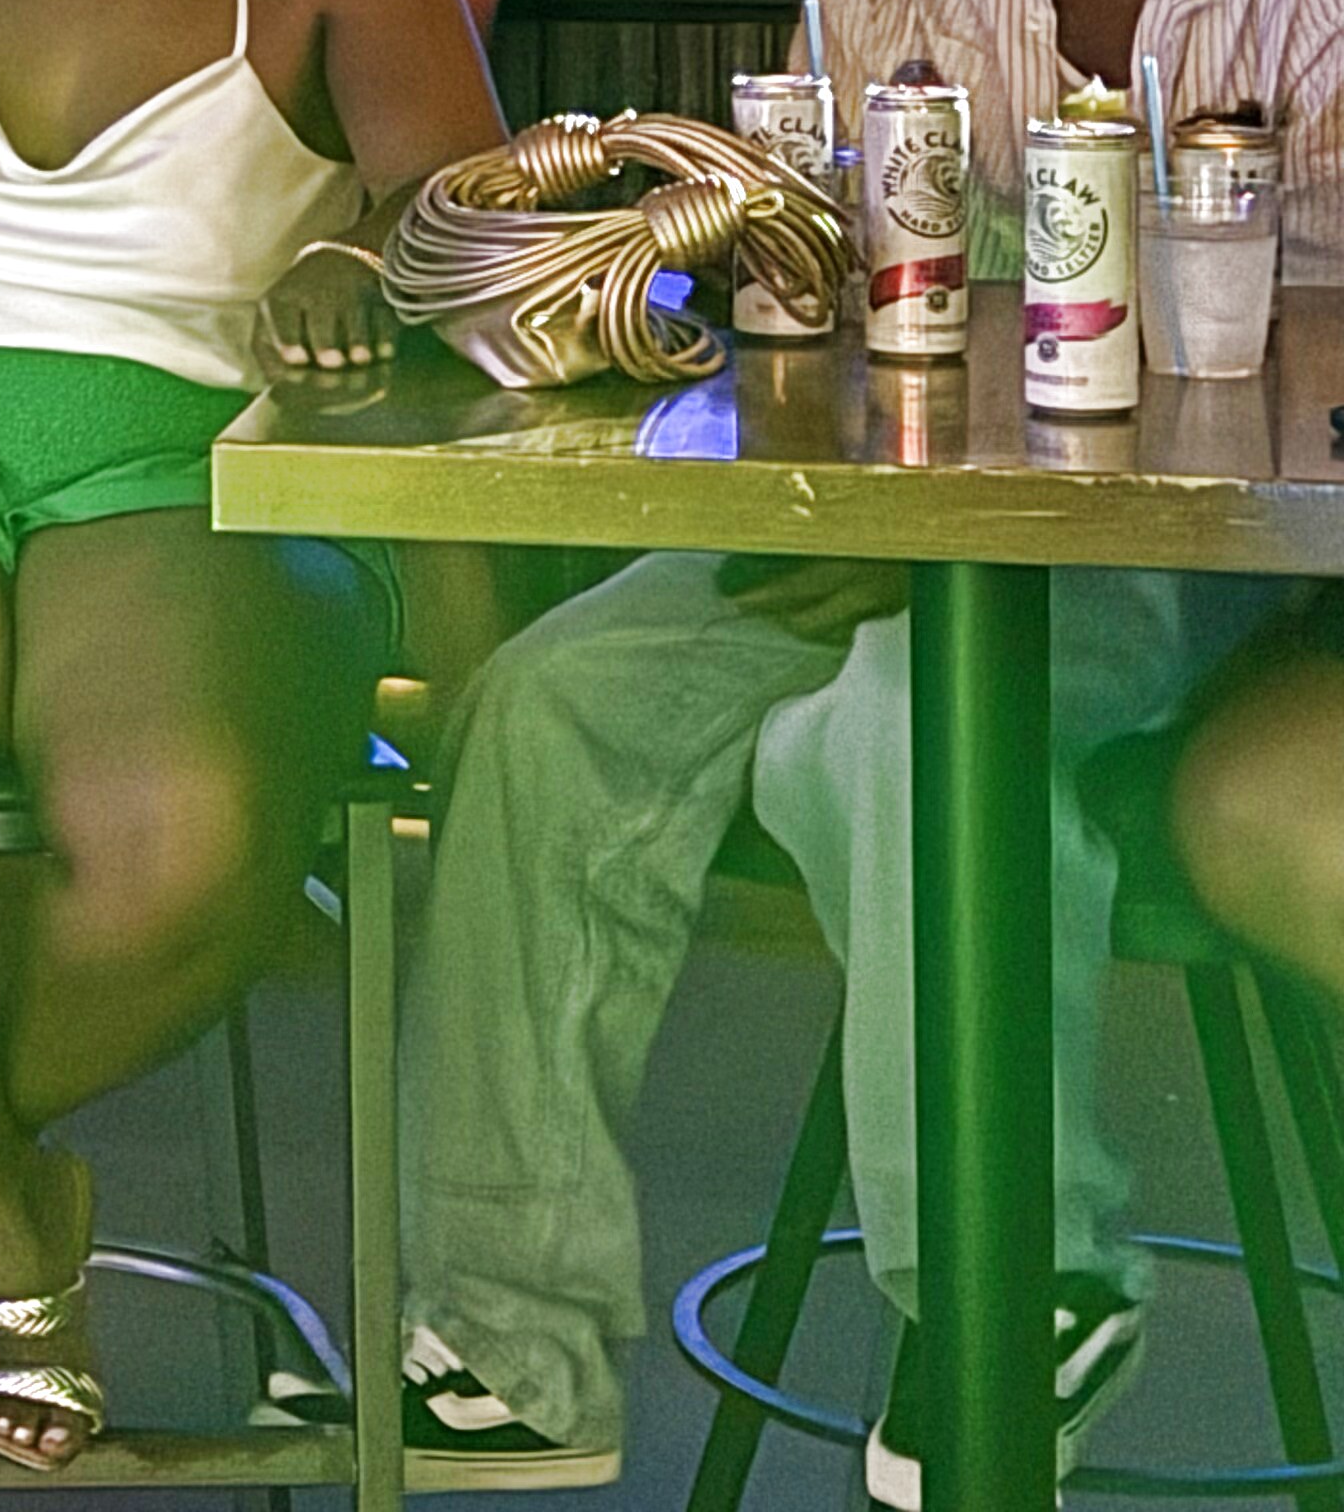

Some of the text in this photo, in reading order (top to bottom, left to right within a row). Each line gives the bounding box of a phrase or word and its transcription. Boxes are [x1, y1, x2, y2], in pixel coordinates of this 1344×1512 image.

[882, 137, 920, 199] WHITE
[1036, 168, 1101, 206] CLAW
[1056, 222, 1101, 275] SELTZER
